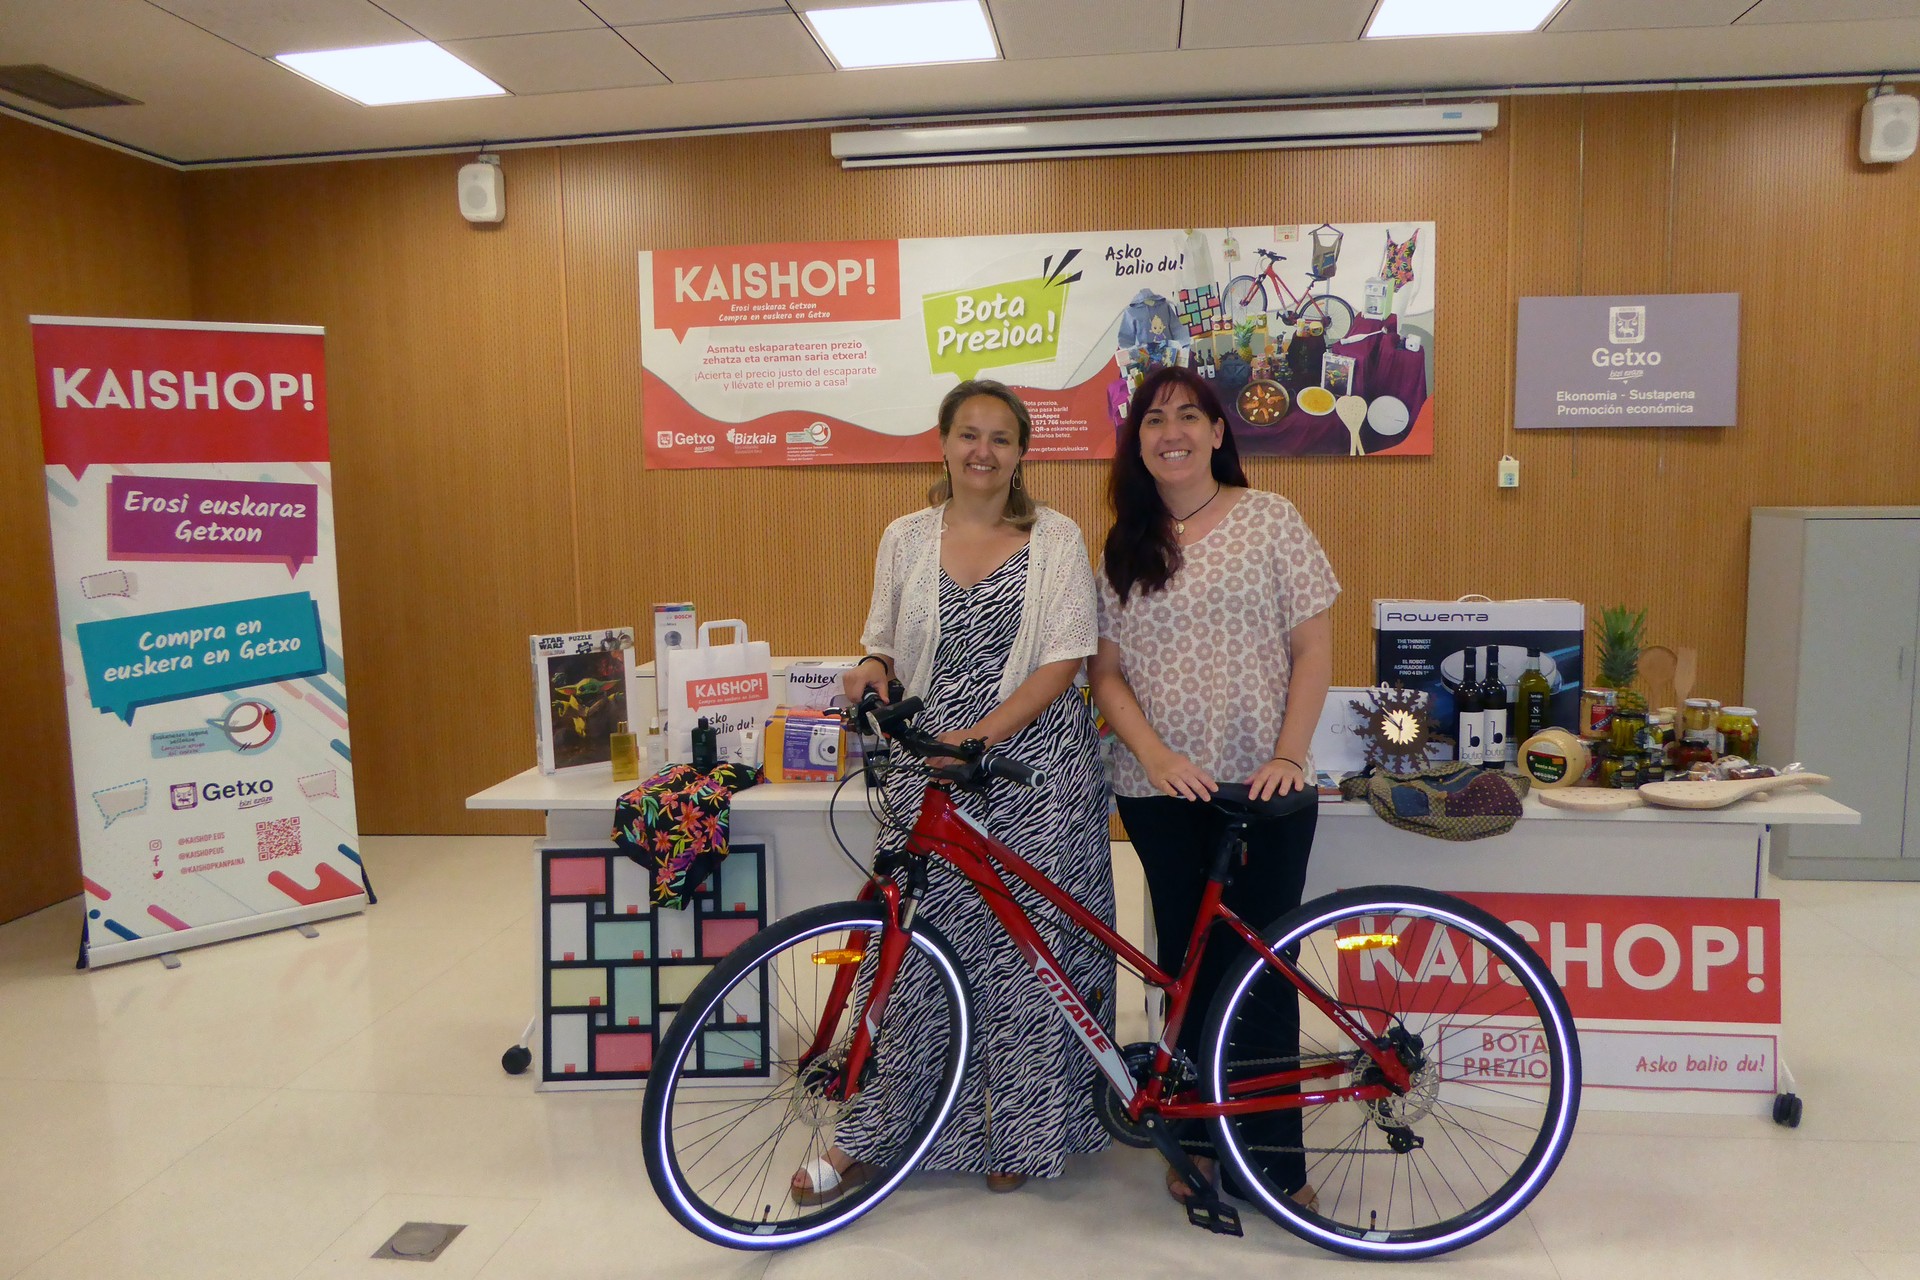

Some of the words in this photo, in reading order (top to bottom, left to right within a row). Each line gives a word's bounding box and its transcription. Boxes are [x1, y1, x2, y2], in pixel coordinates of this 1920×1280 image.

[1105, 243, 1142, 261] Asko
[1115, 259, 1154, 277] balio
[1157, 254, 1185, 272] du!
[674, 258, 876, 303] KAISHOP!
[718, 313, 748, 323] Compra
[763, 312, 793, 321] euskera
[808, 311, 831, 319] Getxo
[730, 304, 751, 313] Erosi
[752, 303, 787, 312] euskaraz
[789, 302, 817, 310] Getxon
[954, 293, 1025, 325] Bota
[937, 310, 1056, 356] Prezioa!
[706, 345, 746, 354] Asmatu
[748, 342, 828, 354] eskaparatearen
[830, 340, 862, 352] prezio
[703, 355, 742, 365] zehatza
[744, 355, 761, 363] eta
[763, 355, 802, 363] eraman
[804, 353, 829, 362] saria
[832, 351, 867, 361] etxera!
[1591, 347, 1662, 368] Getxo
[694, 370, 732, 382] ¡Acierta
[734, 370, 743, 379] el
[745, 369, 776, 380] precio
[777, 368, 803, 380] justo
[805, 367, 821, 377] del
[823, 366, 877, 378] escaparate
[723, 382, 729, 390] y
[732, 378, 763, 390] llévate
[766, 379, 775, 388] el
[777, 379, 812, 389] premio
[823, 377, 848, 387] casa!
[52, 367, 315, 411] KAISHOP!
[1556, 391, 1618, 402] Ekonomia
[1629, 389, 1696, 401] Sustapena
[1557, 404, 1623, 416] Promoción
[1626, 402, 1694, 414] económica
[675, 432, 716, 445] Getxo
[734, 432, 777, 445] Bizkaia
[124, 490, 189, 514] Erosi
[199, 494, 307, 518] euskaraz
[174, 520, 263, 543] Getxon
[138, 626, 226, 651] Compra
[235, 619, 262, 636] en
[539, 636, 564, 645] STAR
[568, 634, 593, 642] PUZZLE
[539, 642, 565, 650] WARS
[103, 656, 193, 682] euskera
[202, 649, 230, 666] en
[239, 637, 301, 660] Getxo
[695, 677, 763, 698] KAISHOP!
[789, 672, 838, 685] habitex
[709, 712, 727, 725] sko
[715, 722, 734, 736] alio
[736, 716, 754, 731] du!
[202, 779, 274, 801] Getxo
[1036, 967, 1113, 1054] GITANE
[1482, 1032, 1548, 1054] BOTA
[1464, 1056, 1549, 1079] PREZIO
[1636, 1054, 1678, 1073] Asko
[1686, 1053, 1728, 1073] balio
[1736, 1053, 1766, 1072] du!
